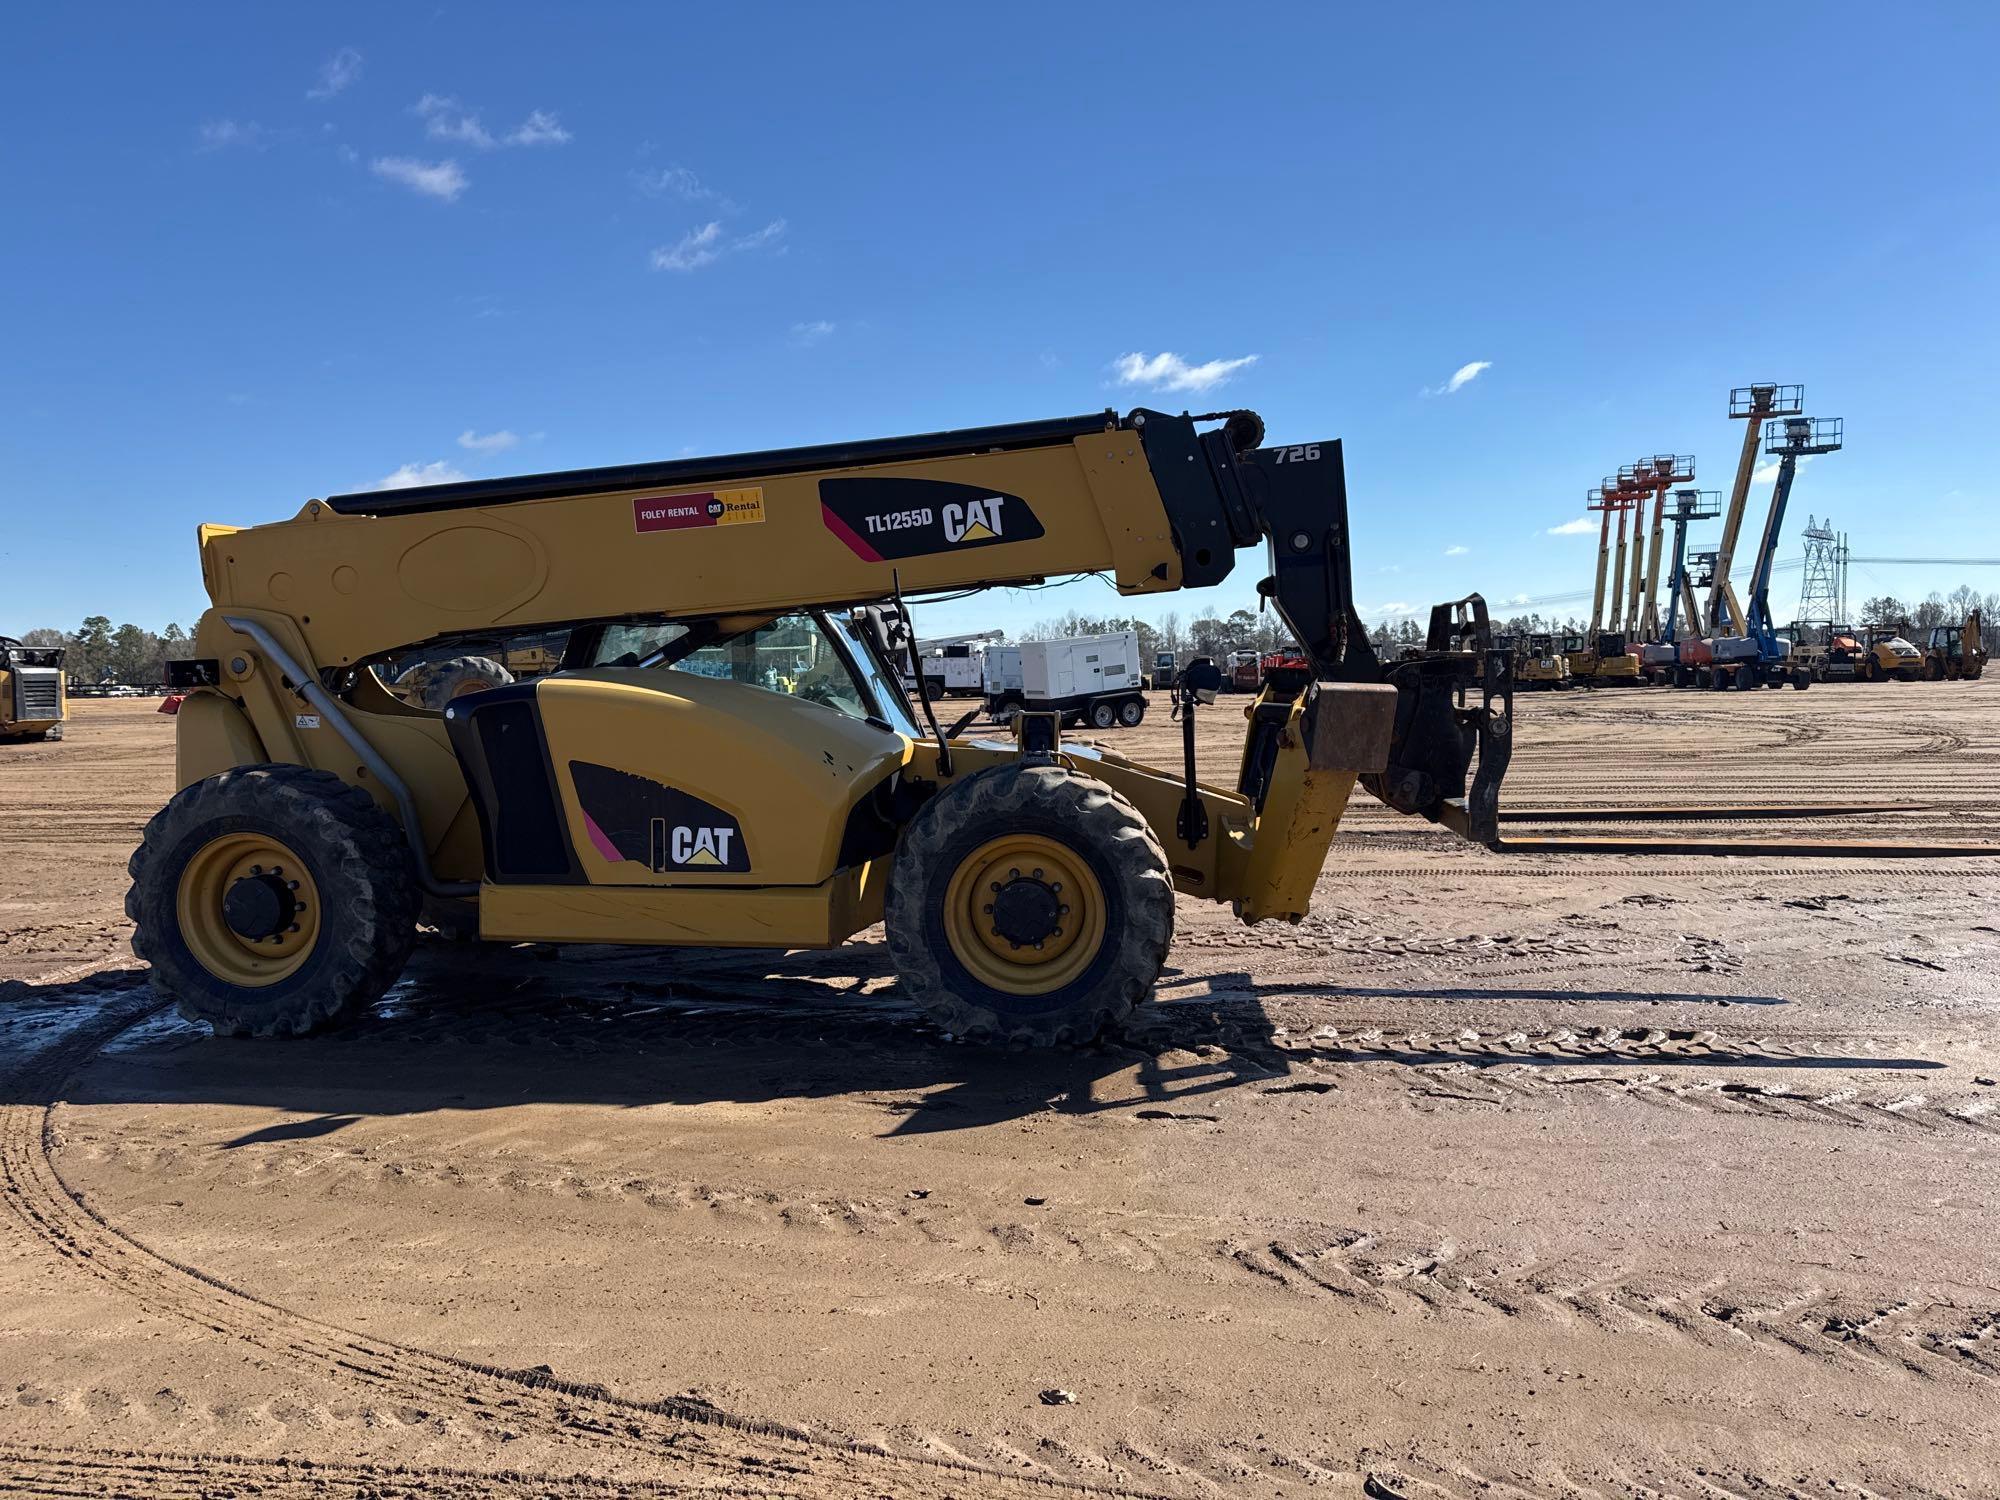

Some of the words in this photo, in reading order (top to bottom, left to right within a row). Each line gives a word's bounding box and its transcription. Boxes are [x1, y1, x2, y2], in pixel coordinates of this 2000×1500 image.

[1273, 444, 1321, 464] 726
[641, 509, 666, 520] FOLEY
[668, 506, 699, 518] RENTAL
[708, 504, 721, 513] CAT
[726, 500, 760, 512] Rental
[865, 508, 933, 533] TL1255D
[942, 497, 1004, 543] CAT
[1540, 659, 1554, 669] CAT
[671, 826, 734, 866] CAT
